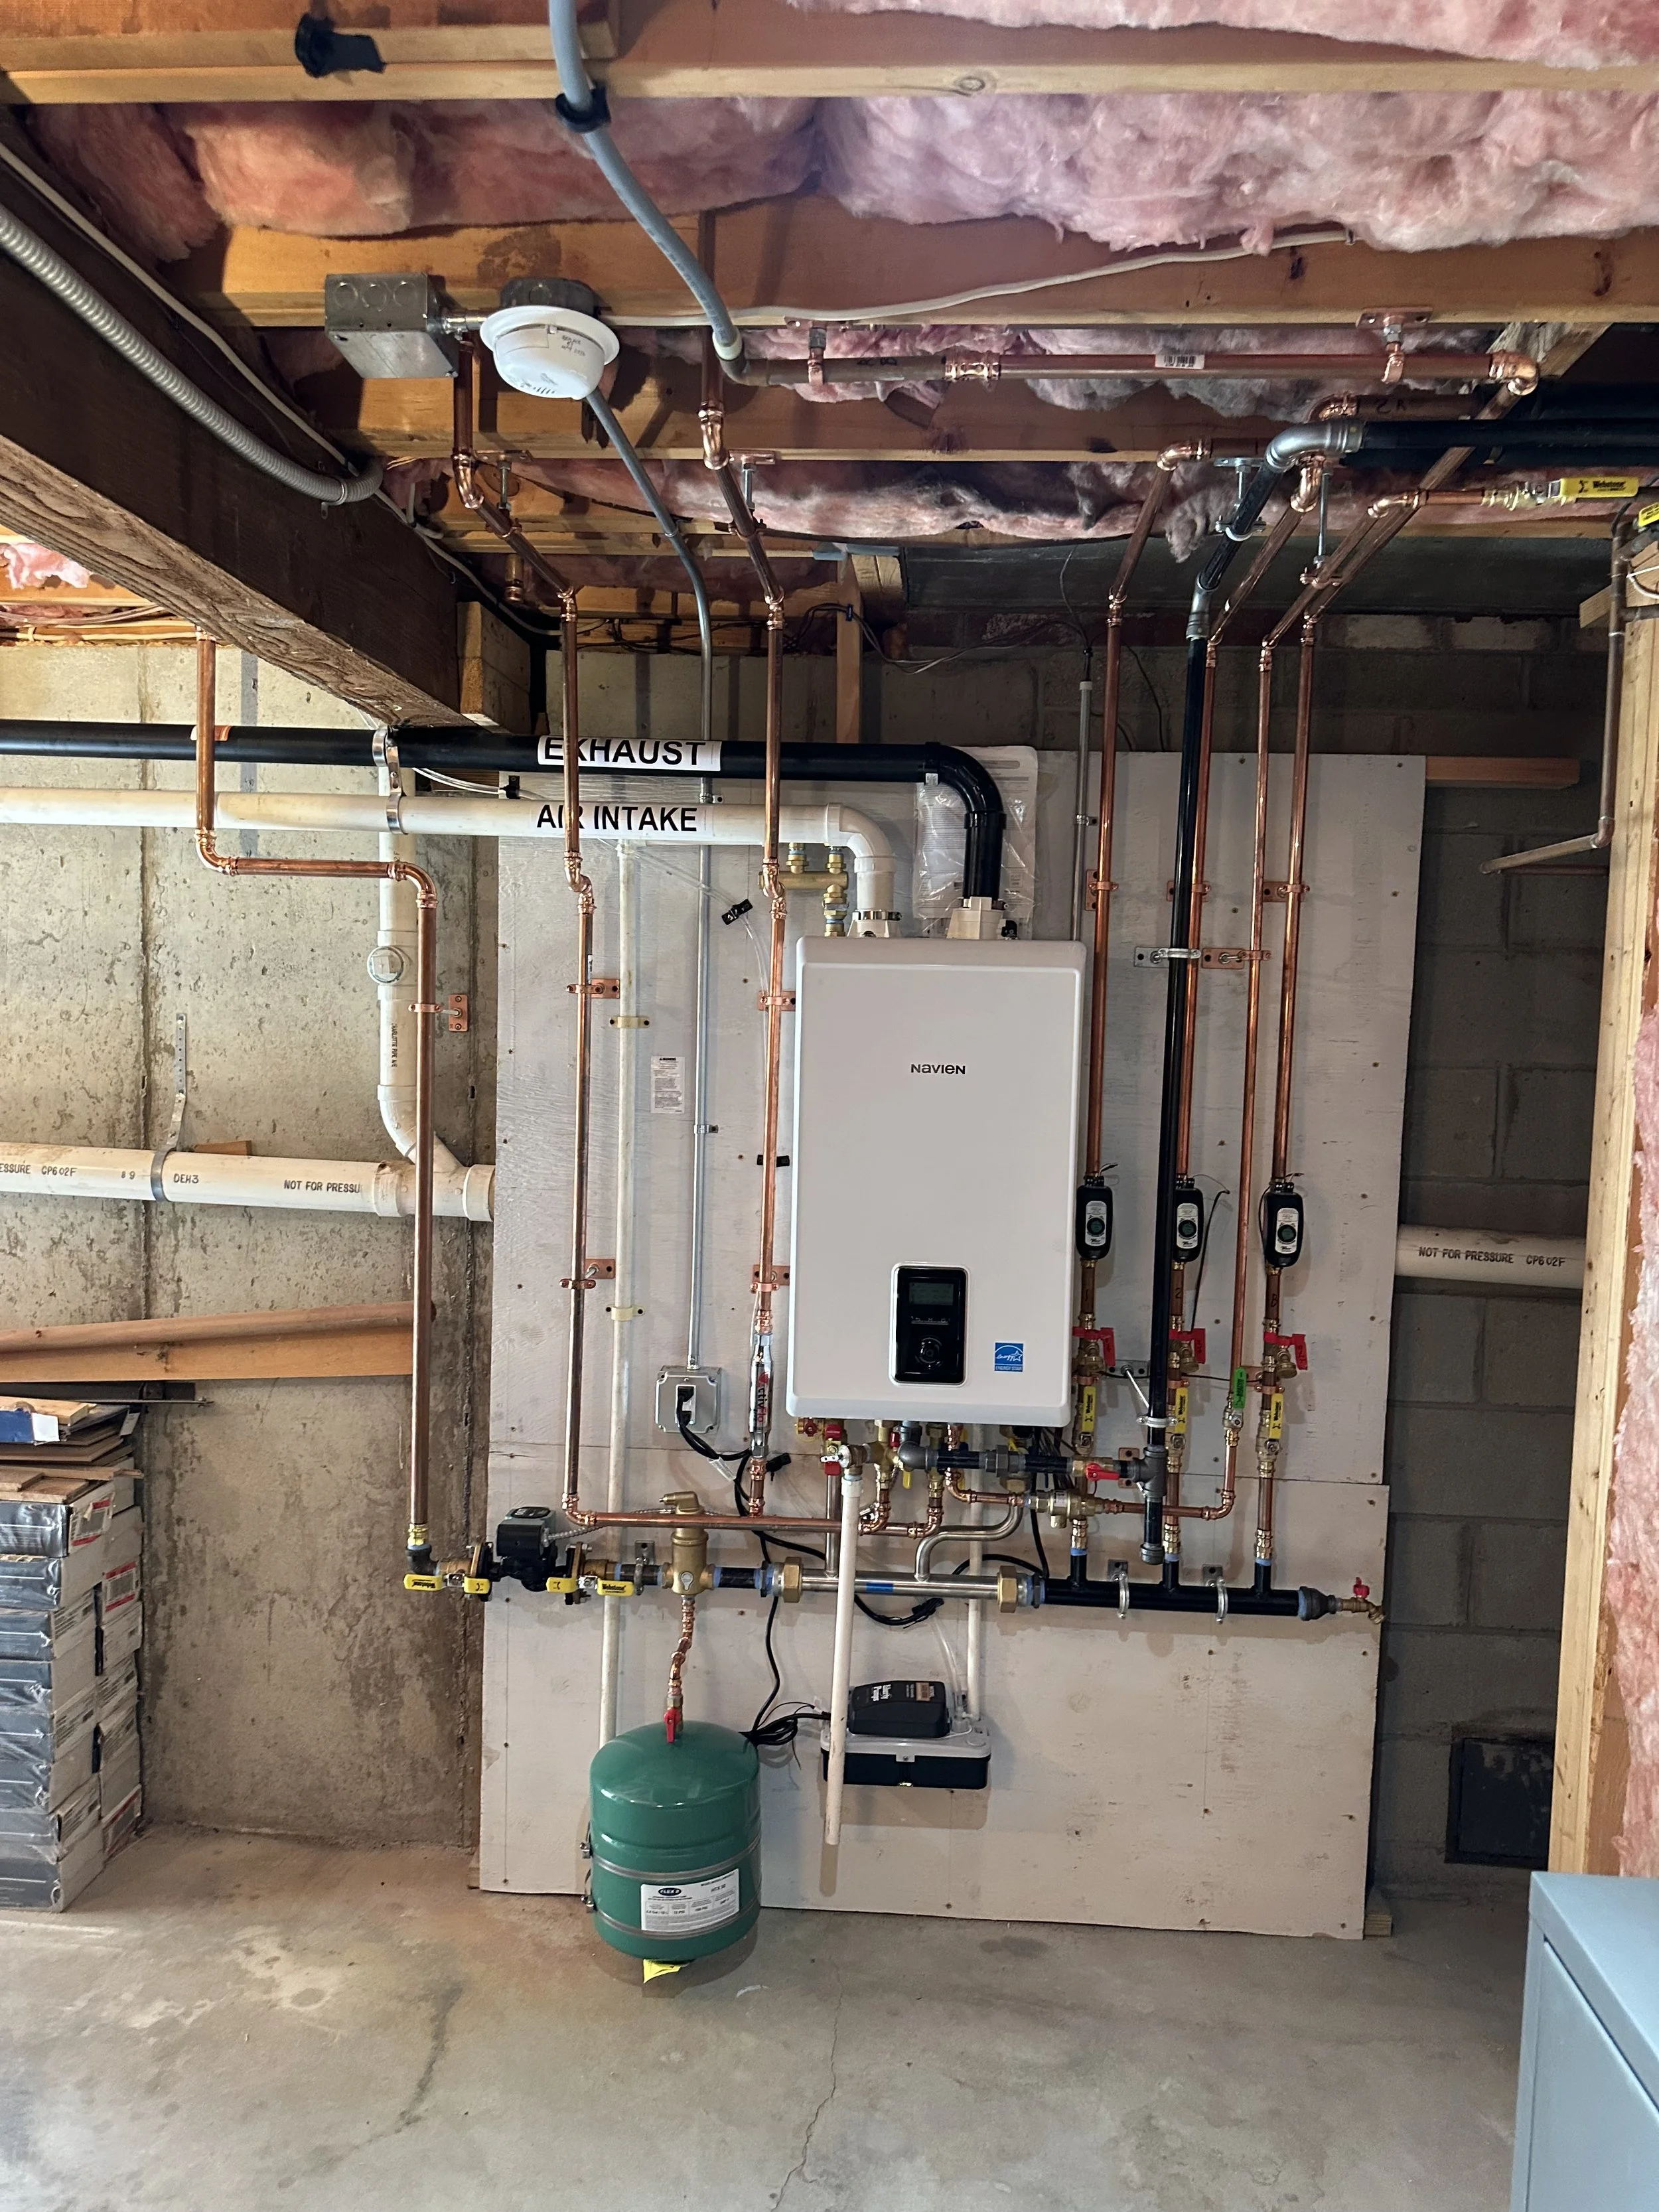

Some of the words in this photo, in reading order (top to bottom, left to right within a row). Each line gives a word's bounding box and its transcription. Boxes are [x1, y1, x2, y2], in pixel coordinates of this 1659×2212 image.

[594, 805, 697, 832] INTAKE
[284, 1179, 303, 1190] NOT
[305, 1181, 323, 1191] FOR
[1419, 1246, 1439, 1258] NOT
[1442, 1248, 1461, 1260] FOR
[1465, 1250, 1515, 1264] PRESSURE
[1175, 1288, 1181, 1299] 2
